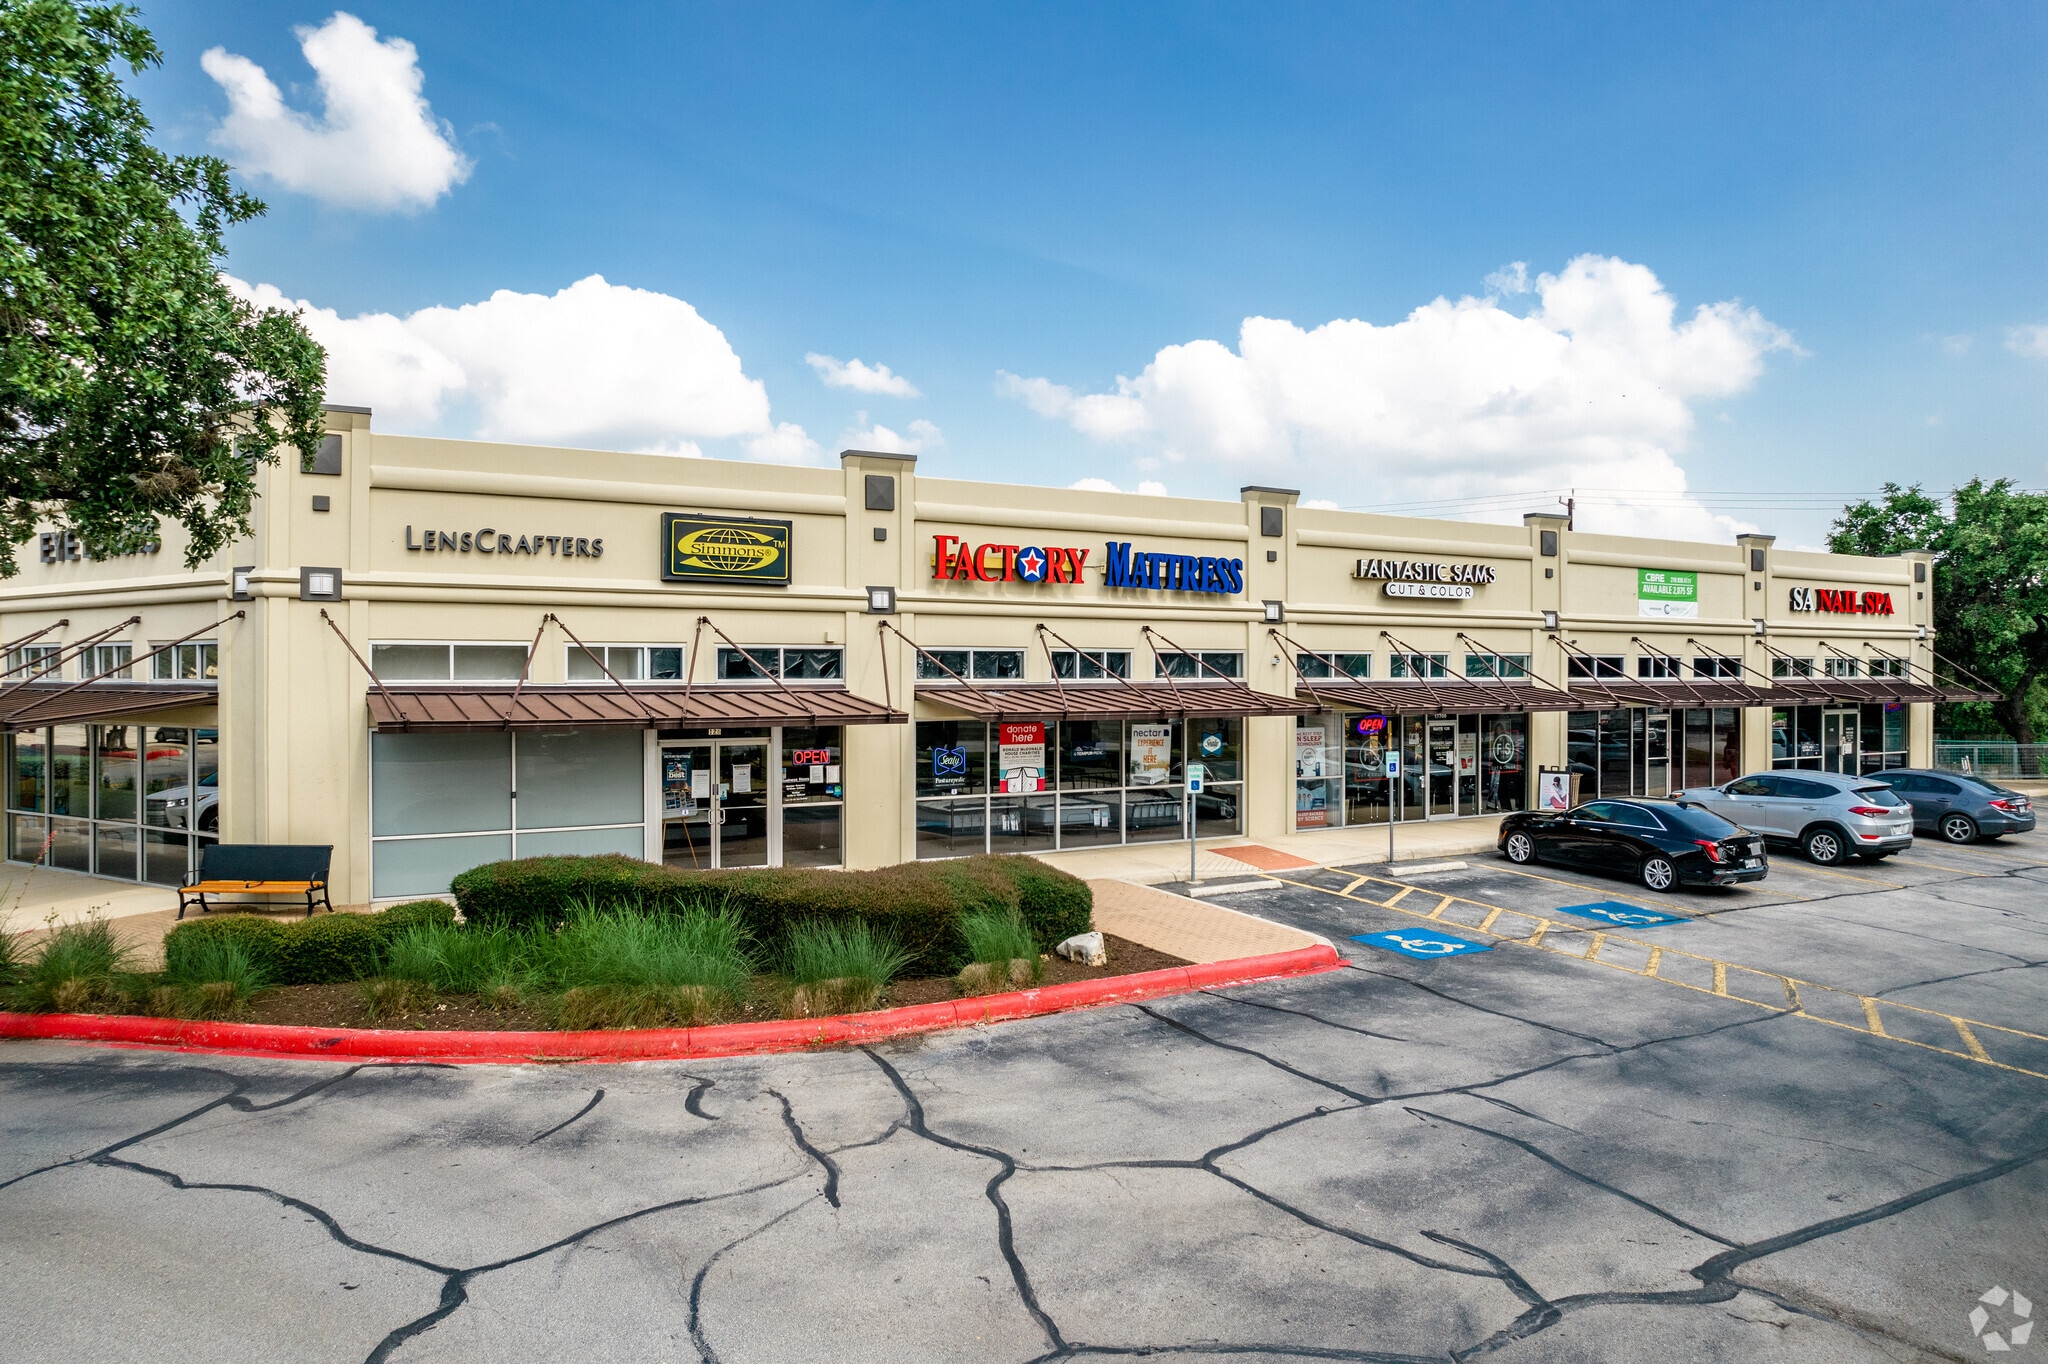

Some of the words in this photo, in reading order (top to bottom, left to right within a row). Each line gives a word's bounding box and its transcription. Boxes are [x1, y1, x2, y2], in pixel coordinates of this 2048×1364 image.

[932, 535, 1090, 584] FACTORY
[1104, 541, 1243, 594] MATTRESS
[1357, 559, 1448, 581] FANTASTIC
[1450, 564, 1497, 584] SAMS
[1645, 573, 1665, 583] CBRE
[1389, 584, 1415, 595] CUT
[1418, 585, 1426, 596] &
[1430, 586, 1472, 597] COLOR
[1642, 584, 1672, 594] AVAILABLE
[1790, 587, 1815, 611] SA
[1816, 589, 1862, 613] NAIL
[1862, 591, 1895, 614] SPA
[1006, 725, 1037, 733] donate
[1360, 719, 1384, 730] OPEN
[1012, 734, 1034, 742] here
[1133, 729, 1161, 737] nectar
[794, 750, 830, 764] OPEN
[940, 755, 960, 766] Sealy
[1143, 754, 1157, 763] HERE
